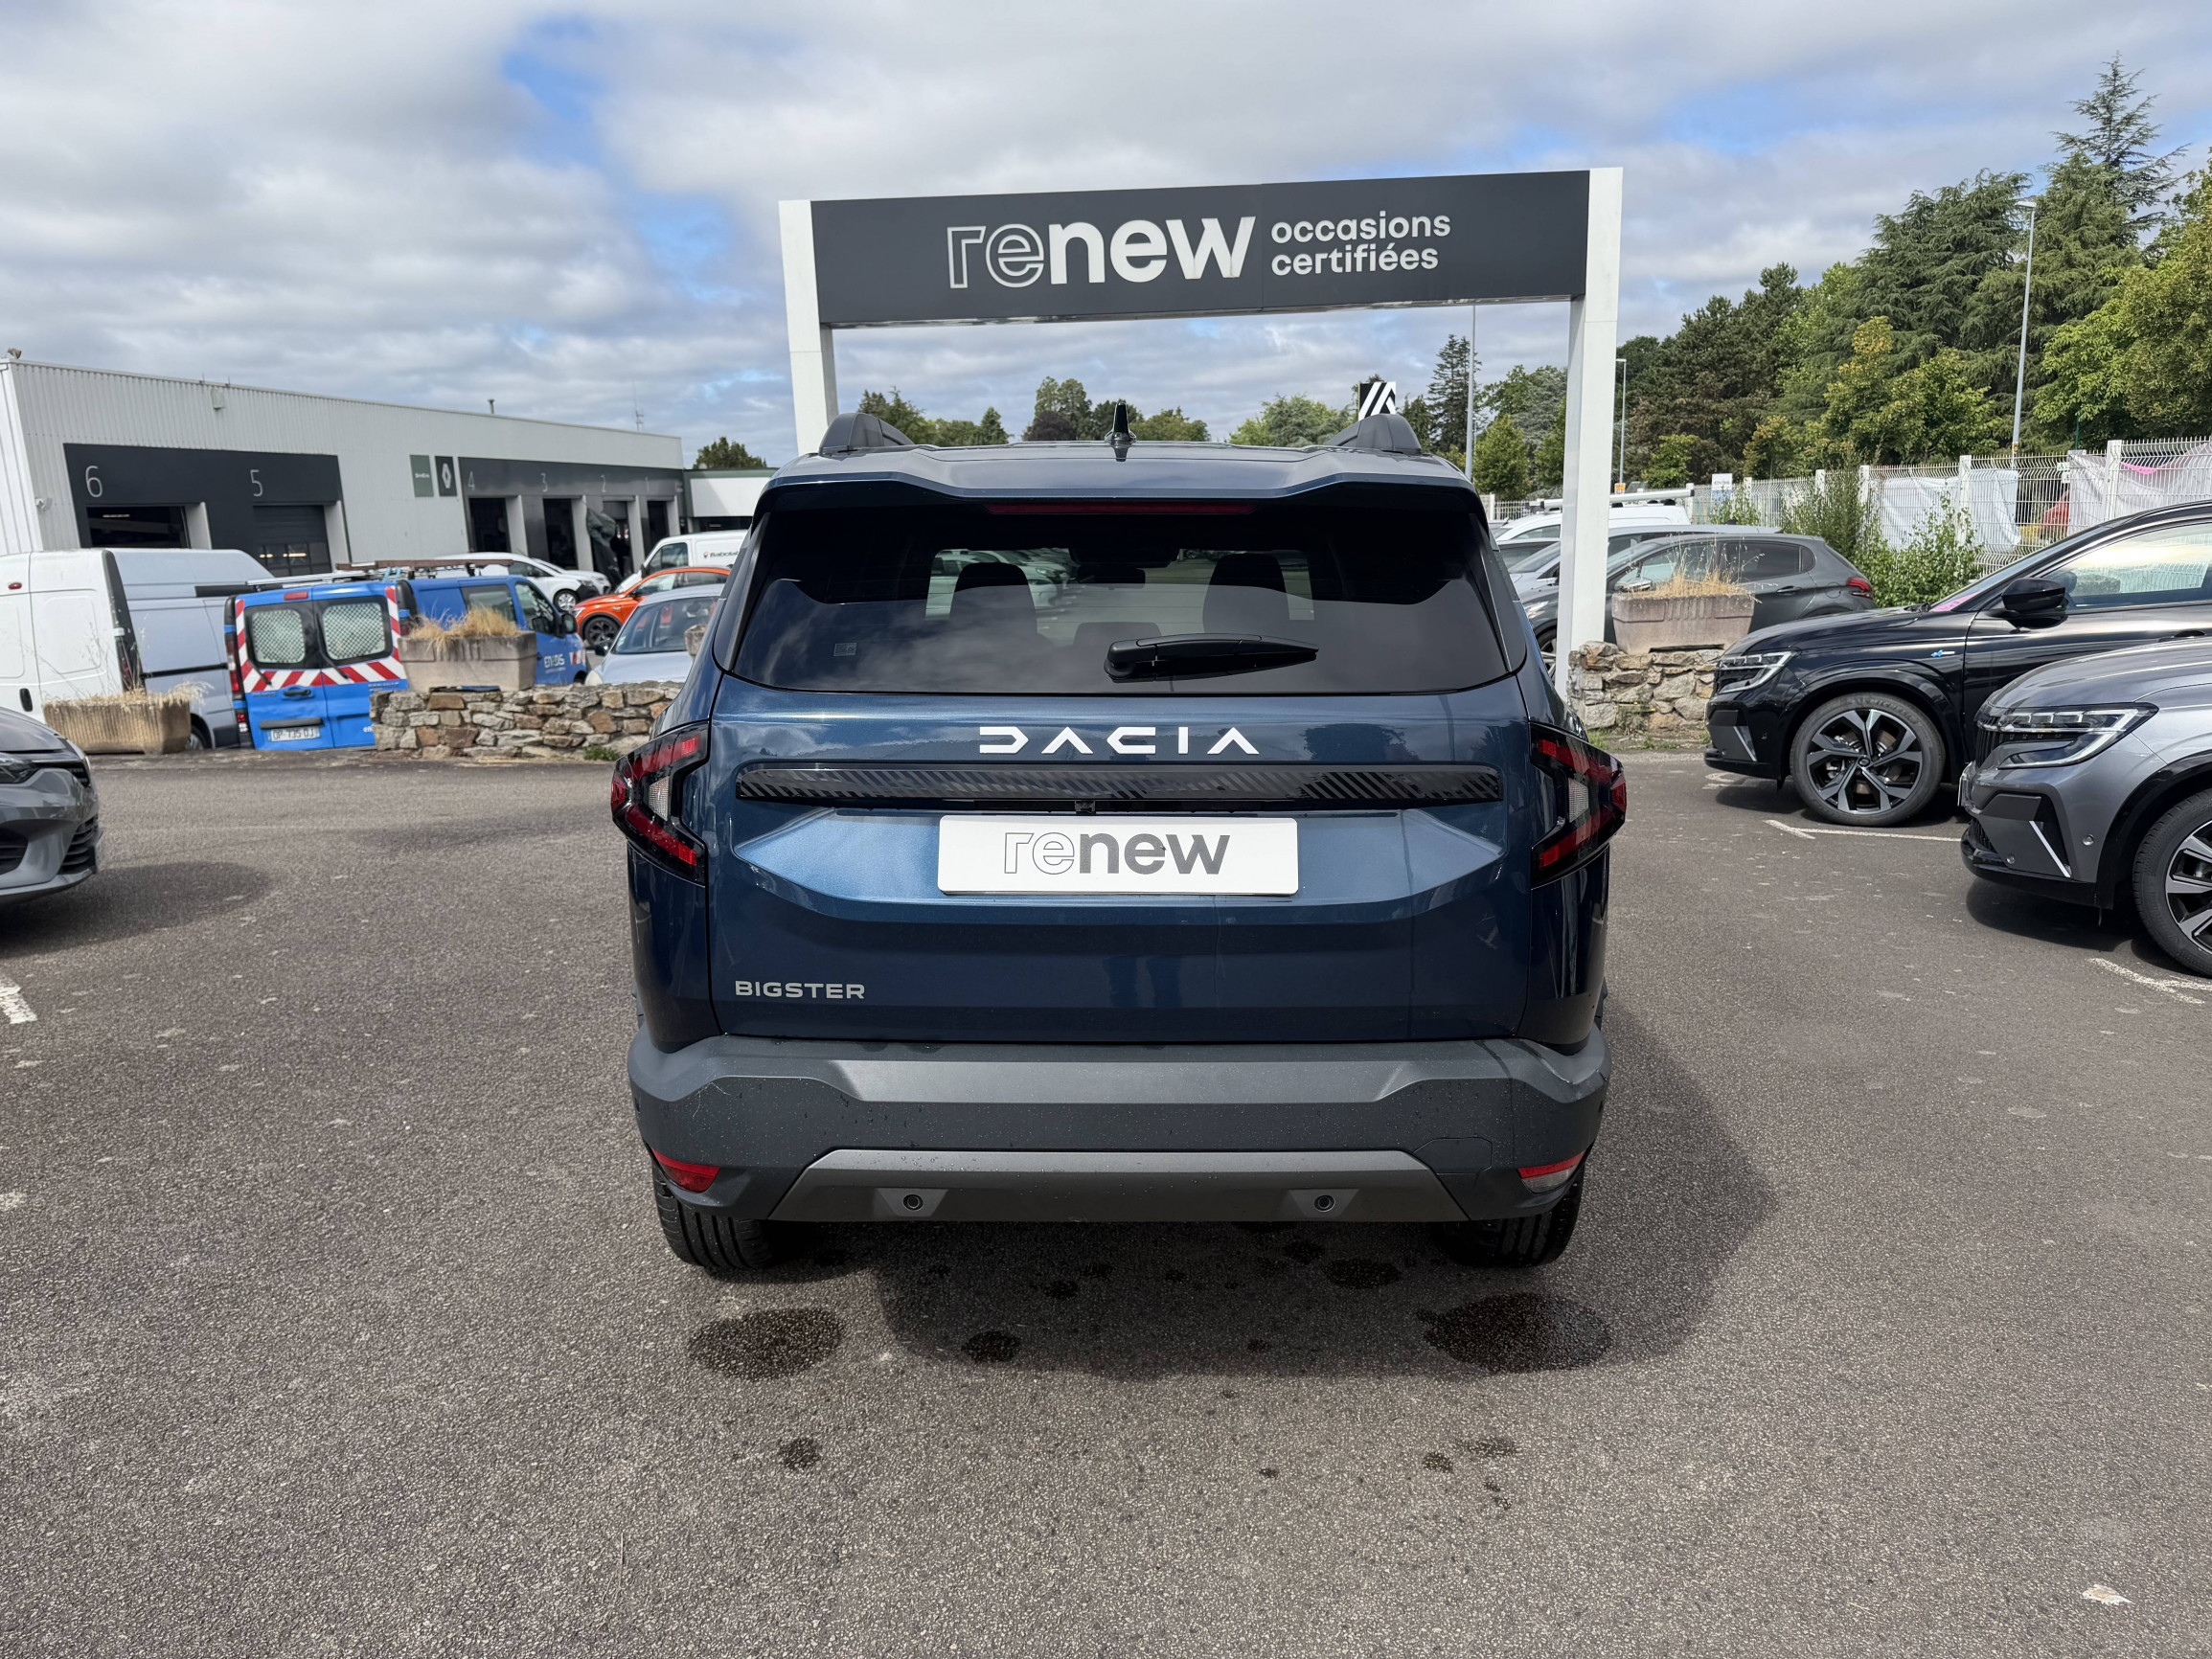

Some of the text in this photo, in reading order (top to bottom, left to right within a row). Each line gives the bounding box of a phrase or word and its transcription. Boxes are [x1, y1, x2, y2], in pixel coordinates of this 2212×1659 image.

[1270, 210, 1451, 245] occasions
[946, 216, 1256, 289] renew
[1270, 241, 1439, 276] certifiées
[85, 465, 103, 498] 6
[249, 468, 263, 497] 5
[467, 470, 475, 491] 4
[540, 472, 549, 493] 3
[978, 725, 1261, 755] DACIA
[1003, 831, 1231, 875] renew
[735, 980, 865, 999] BIGSTER
